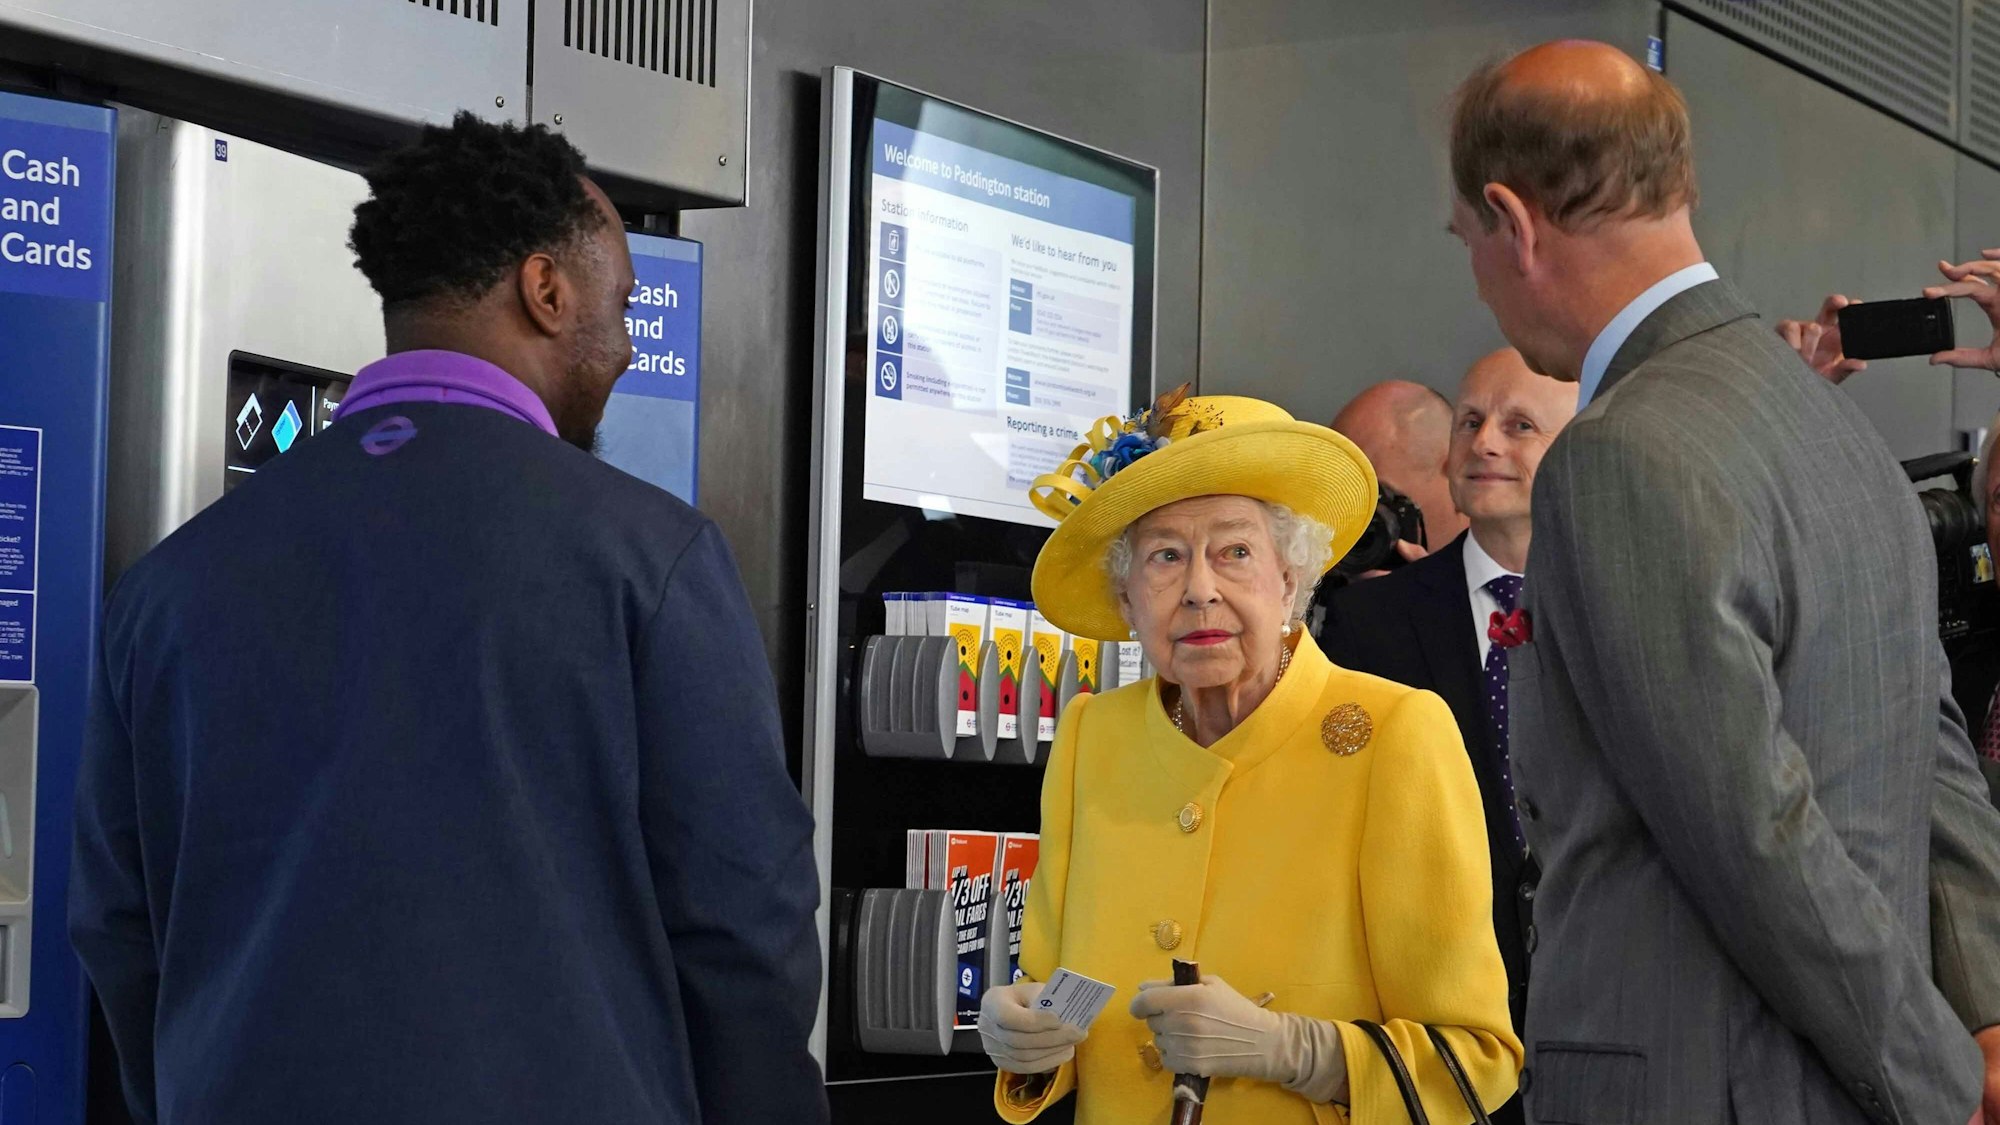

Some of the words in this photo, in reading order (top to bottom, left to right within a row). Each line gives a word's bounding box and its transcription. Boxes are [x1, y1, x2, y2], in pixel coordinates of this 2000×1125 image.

[216, 143, 226, 158] 39
[2, 149, 80, 187] Cash
[884, 143, 938, 176] Welcome
[941, 161, 951, 179] to
[954, 165, 1011, 197] Paddington
[1013, 186, 1050, 208] station
[1, 196, 60, 225] and
[881, 198, 914, 219] Station
[917, 207, 969, 233] information
[0, 232, 92, 270] Cards
[1012, 233, 1031, 250] We'd
[1032, 239, 1045, 254] like
[1047, 245, 1056, 257] to
[1057, 247, 1076, 262] hear
[1078, 251, 1099, 267] from
[1101, 259, 1117, 272] you
[624, 316, 663, 340] and
[1007, 415, 1047, 437] Reporting
[1049, 426, 1054, 436] a
[1056, 427, 1079, 440] crime
[971, 872, 991, 903] OFF
[966, 902, 988, 924] FARES
